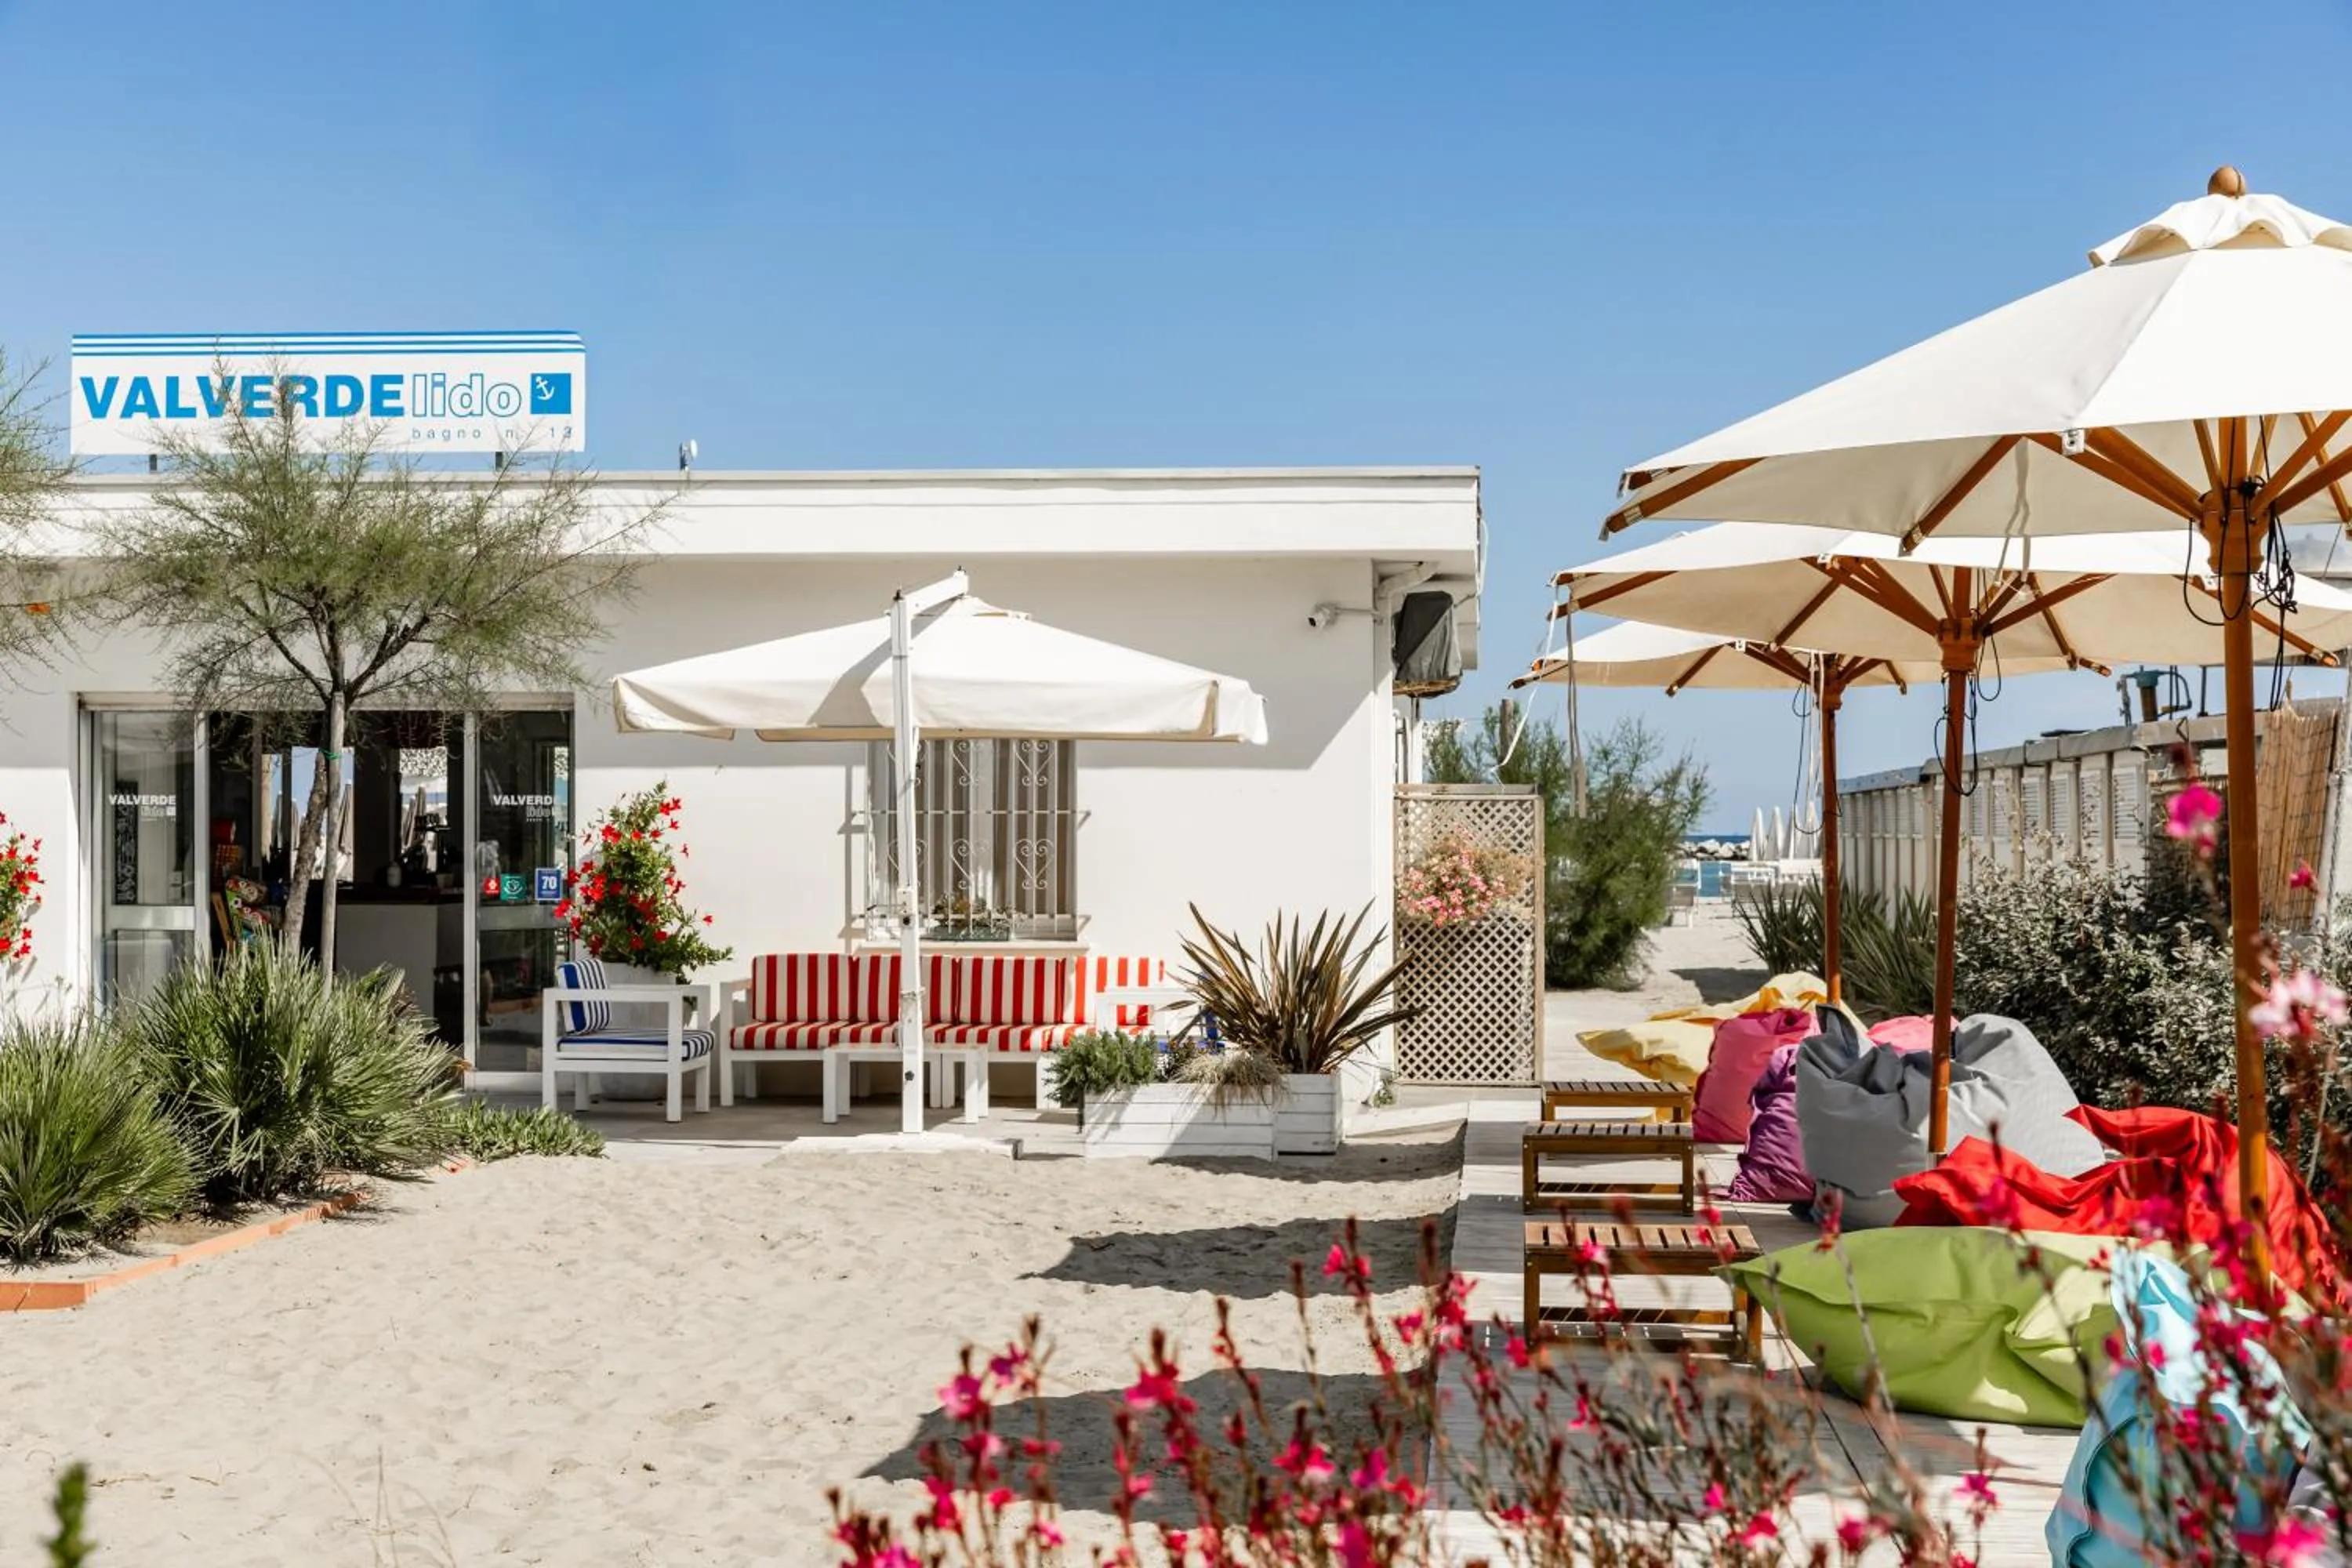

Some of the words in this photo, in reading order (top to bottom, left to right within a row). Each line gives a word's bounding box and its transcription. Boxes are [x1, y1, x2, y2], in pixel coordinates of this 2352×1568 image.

[79, 374, 405, 419] VALVERDE
[412, 372, 522, 417] lido
[412, 426, 481, 441] bagno
[109, 794, 176, 805] VALVERDE
[493, 794, 560, 806] VALVERD
[542, 876, 557, 890] 70
